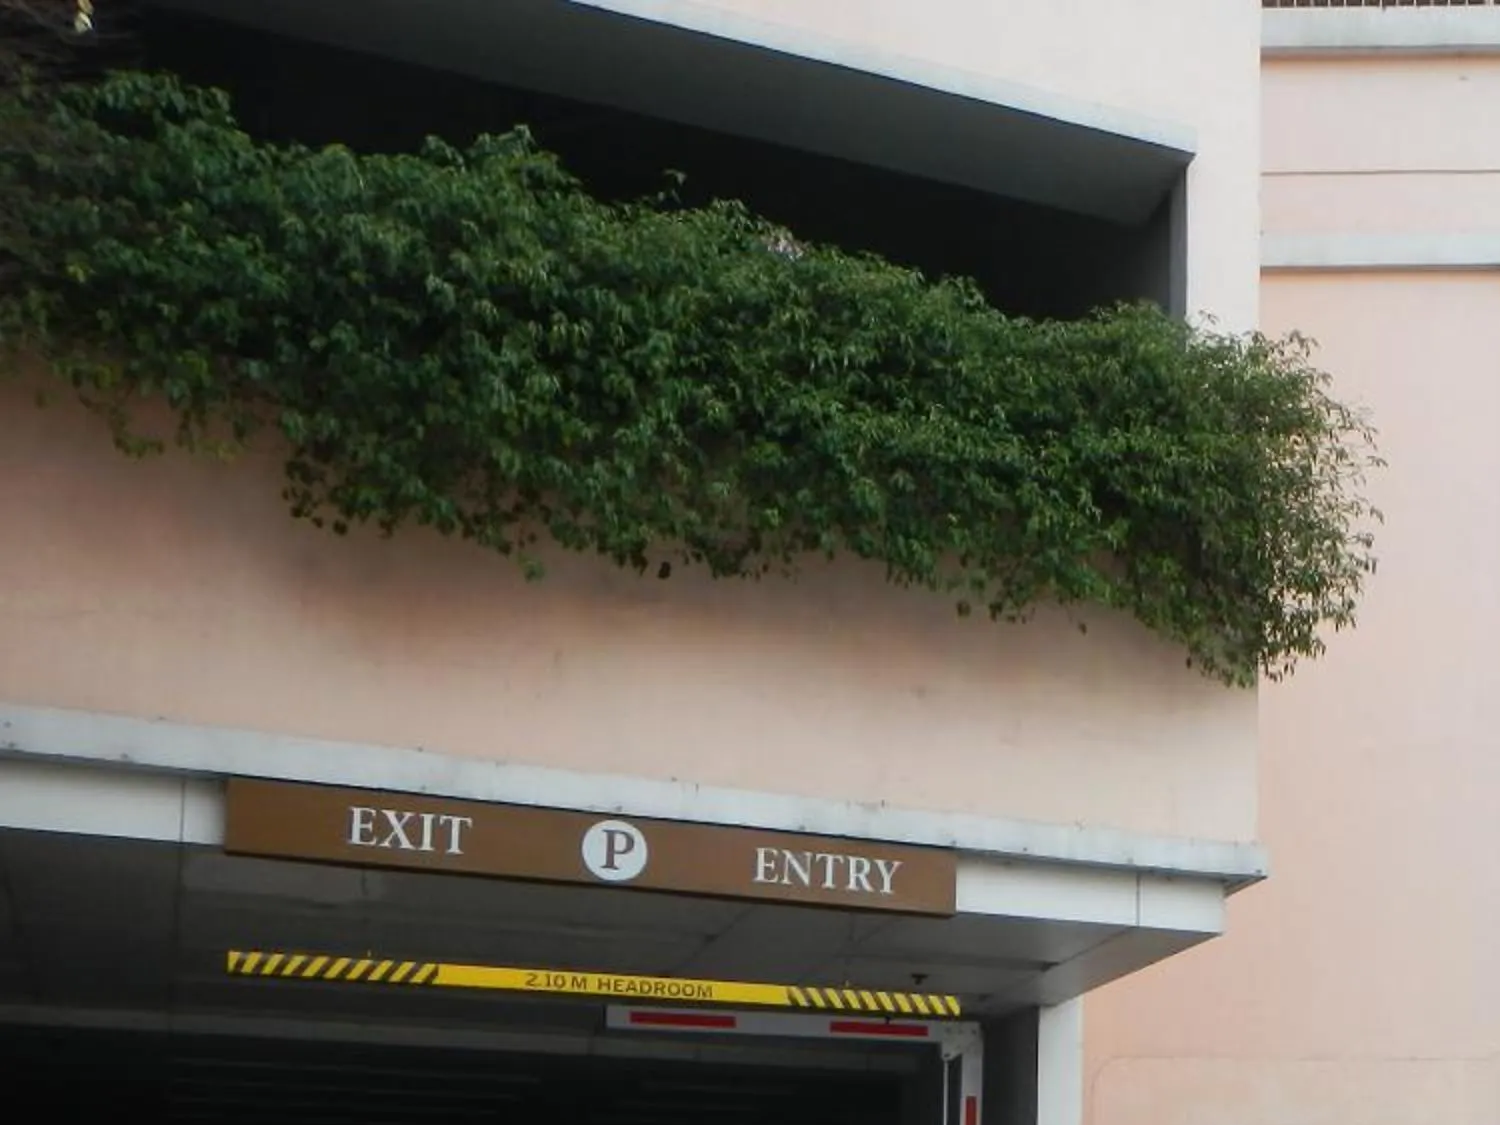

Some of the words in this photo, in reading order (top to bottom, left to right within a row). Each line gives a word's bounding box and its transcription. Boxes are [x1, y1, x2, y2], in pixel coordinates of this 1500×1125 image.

[348, 807, 472, 855] EXIT
[600, 829, 636, 871] P
[755, 848, 902, 895] ENTRY
[597, 978, 714, 999] HEADROOM
